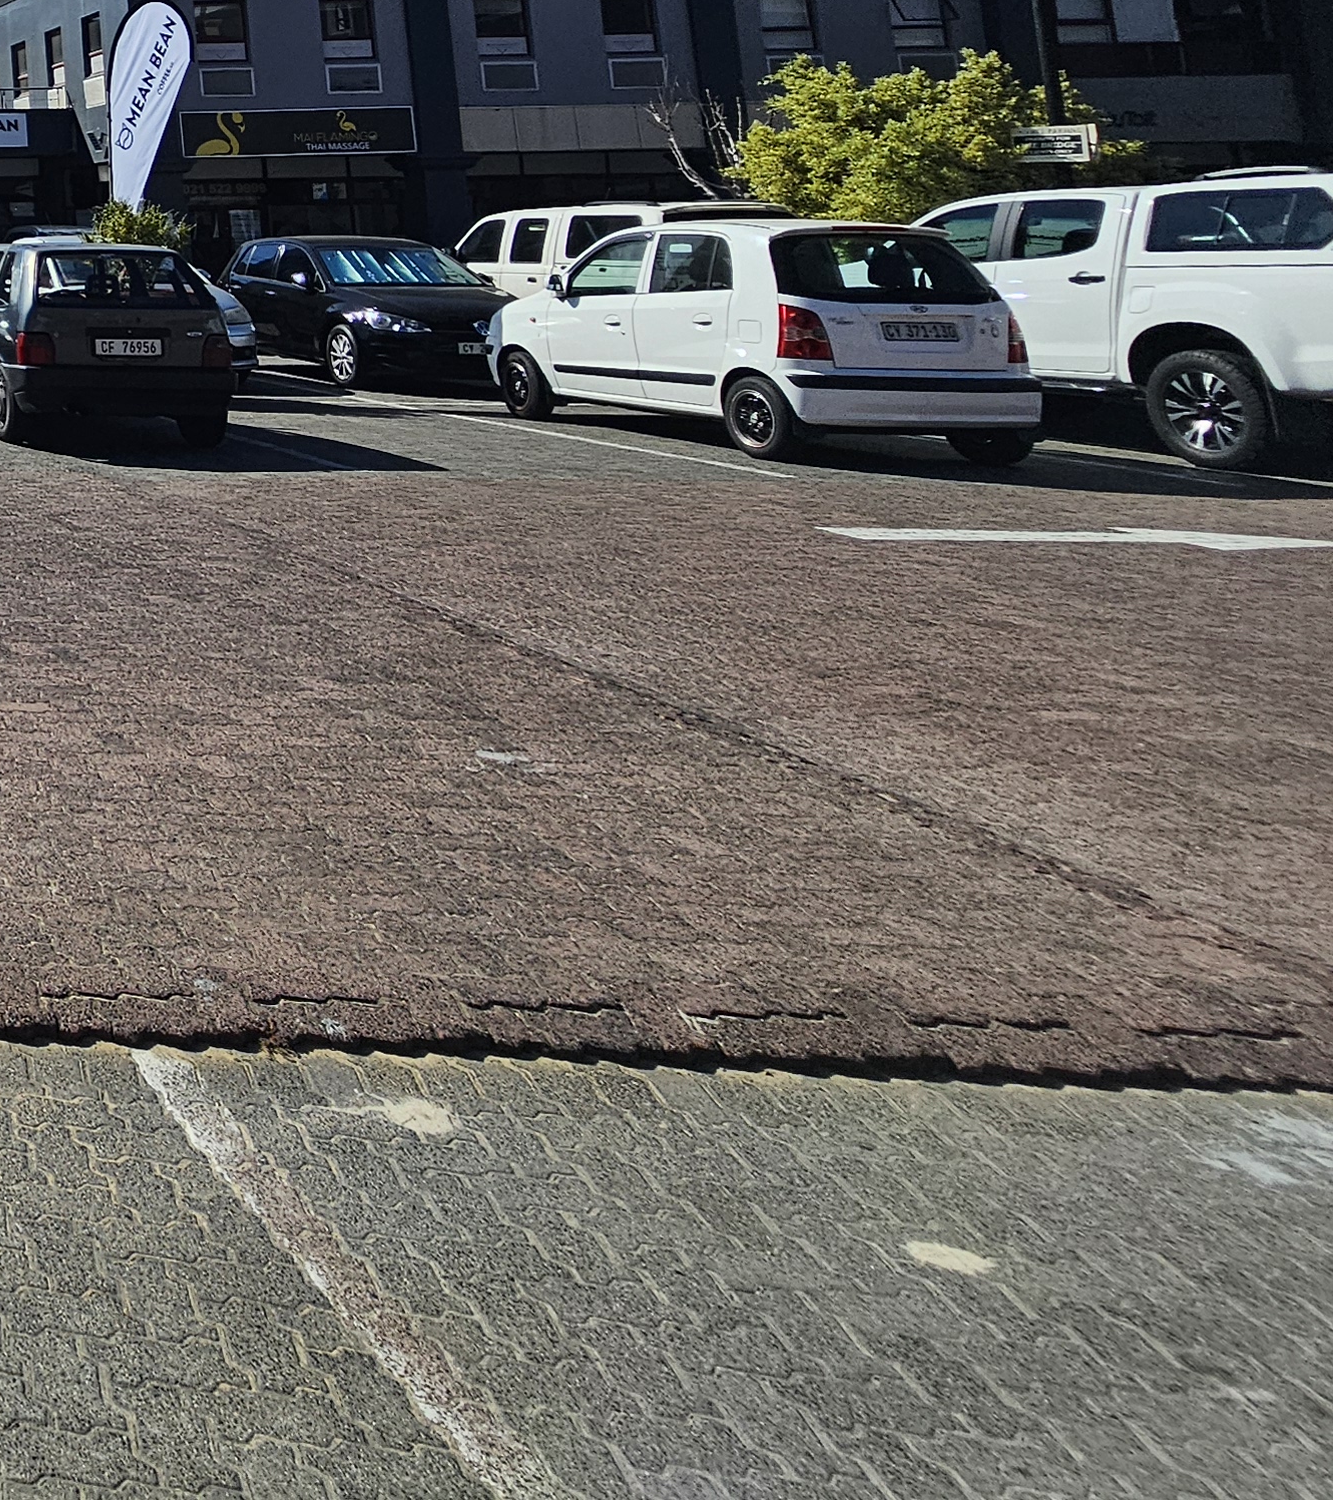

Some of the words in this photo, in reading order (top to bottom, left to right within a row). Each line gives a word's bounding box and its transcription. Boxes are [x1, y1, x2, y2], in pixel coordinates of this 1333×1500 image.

[125, 69, 156, 128] MEAN
[149, 15, 177, 69] BEAN
[293, 133, 315, 143] MAI
[316, 131, 378, 142] FLAMINGO
[328, 141, 370, 150] MASSAGE
[885, 324, 901, 338] CY
[101, 341, 114, 353] CF
[122, 341, 156, 353] 76956
